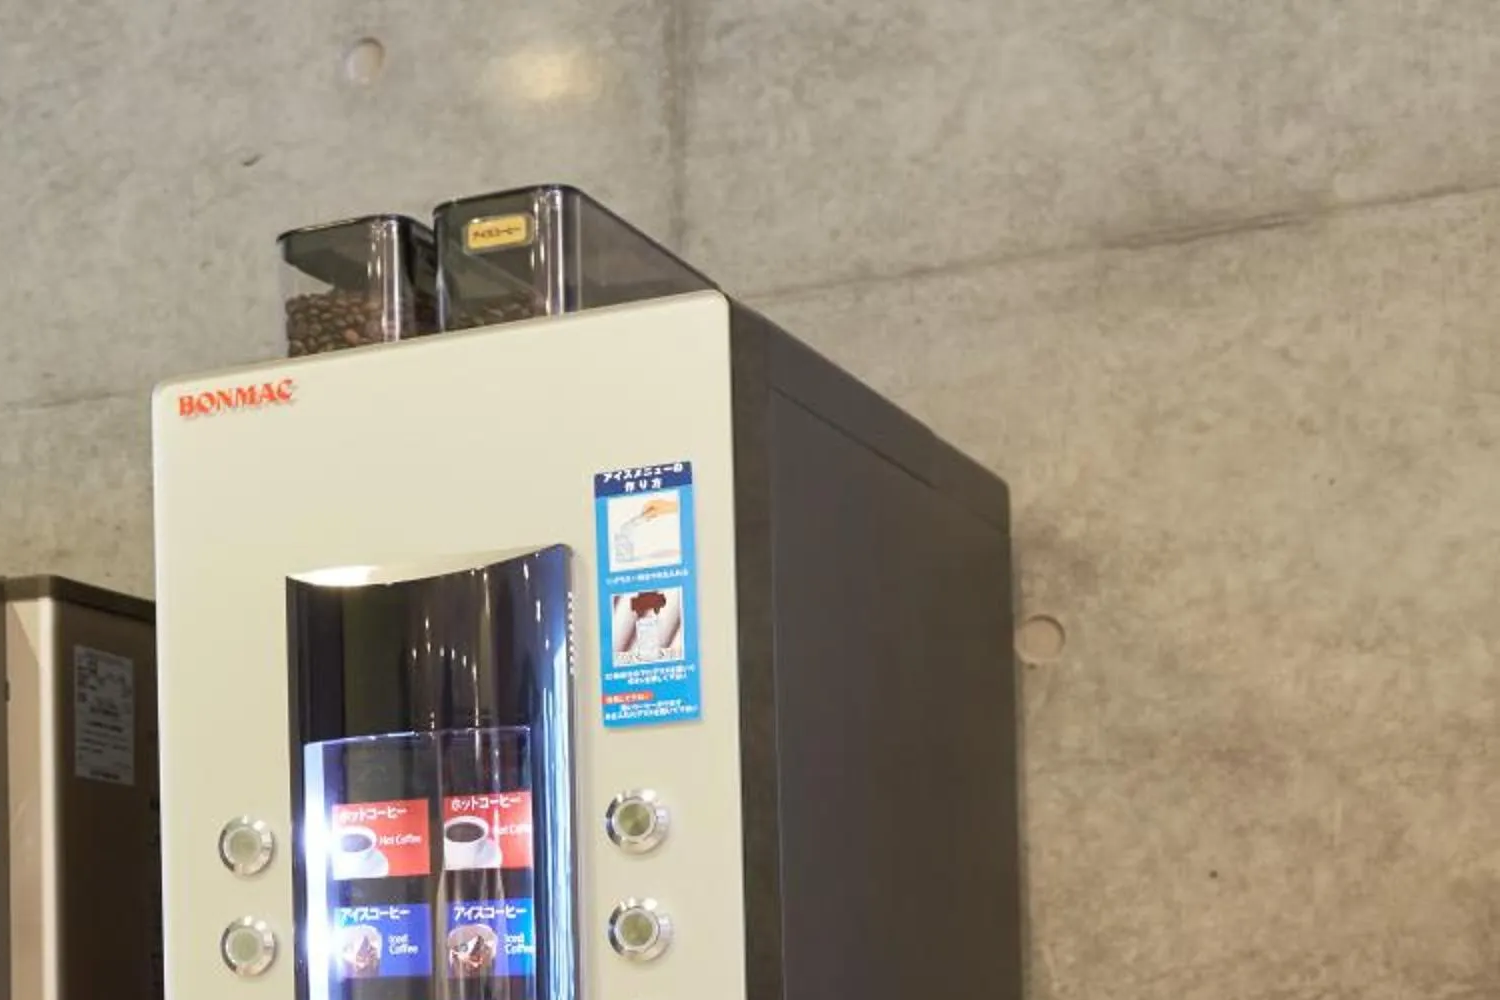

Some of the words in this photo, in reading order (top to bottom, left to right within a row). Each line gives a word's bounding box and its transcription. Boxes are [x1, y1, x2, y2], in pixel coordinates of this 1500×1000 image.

[178, 379, 294, 417] BONMAC
[451, 794, 522, 812] ホットコーヒー
[340, 907, 411, 922] アイスコーヒー
[453, 904, 528, 921] アイスコーヒー
[388, 943, 419, 956] Coffee
